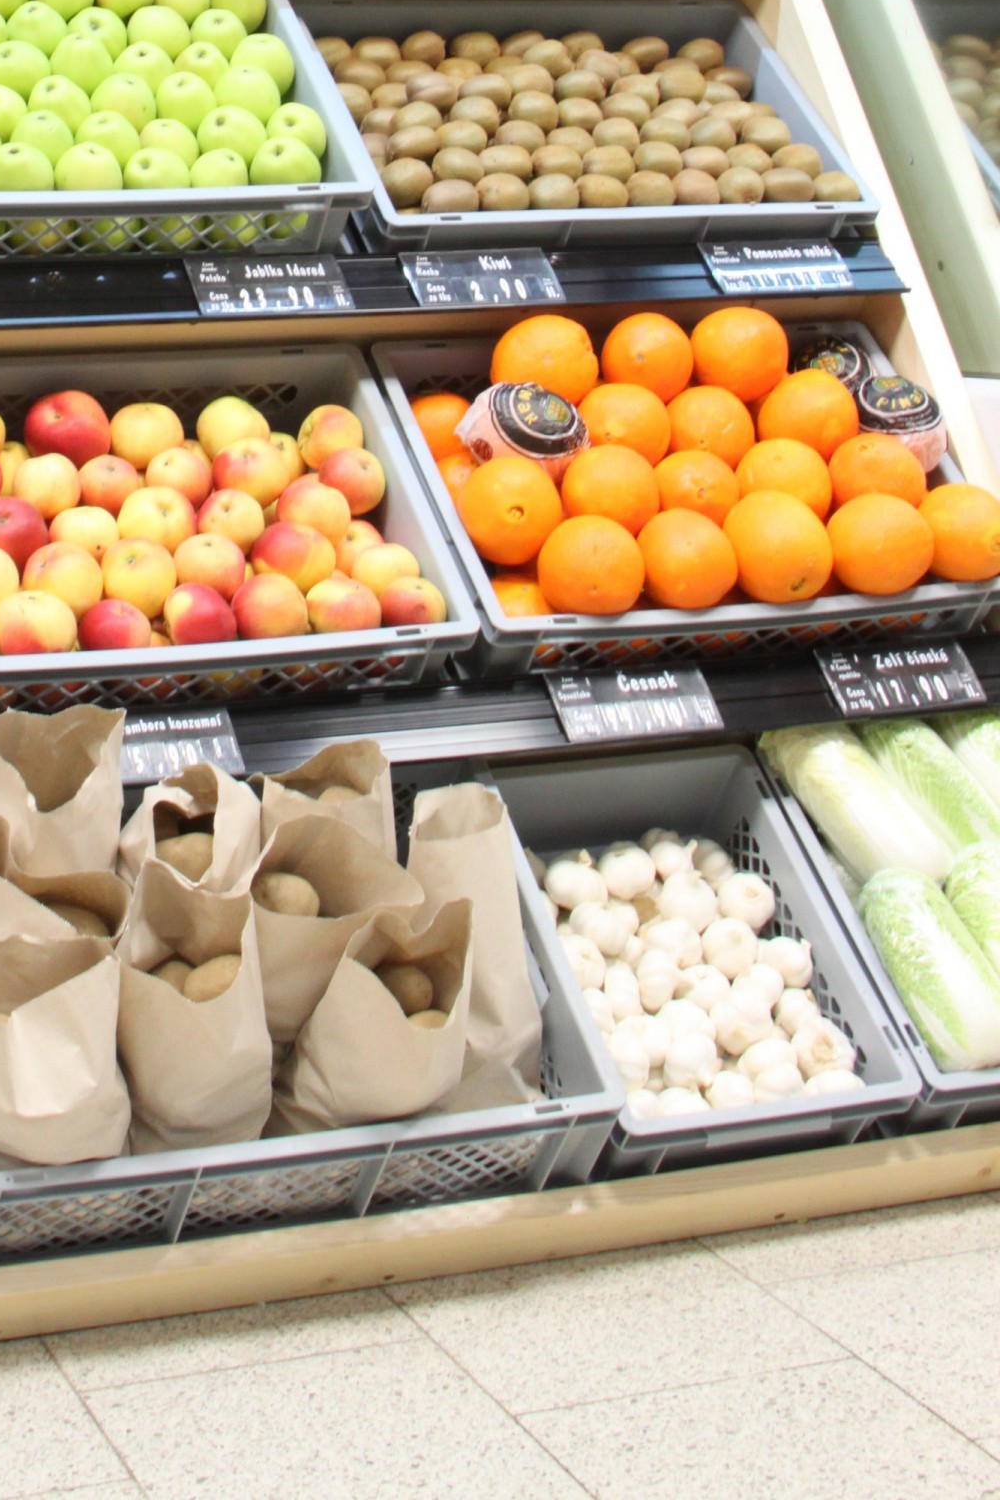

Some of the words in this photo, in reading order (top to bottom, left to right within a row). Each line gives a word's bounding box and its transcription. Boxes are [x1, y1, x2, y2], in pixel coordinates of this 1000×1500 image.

[743, 246, 802, 260] Pomeranče
[803, 244, 832, 258] velké
[244, 264, 284, 279] Jablka
[286, 263, 326, 277] Idared
[478, 255, 513, 271] Kiwi
[873, 652, 904, 670] Zelí
[904, 647, 949, 666] čínské
[616, 670, 678, 693] Česnek
[124, 718, 166, 735] ambora
[167, 713, 221, 730] konzumní
